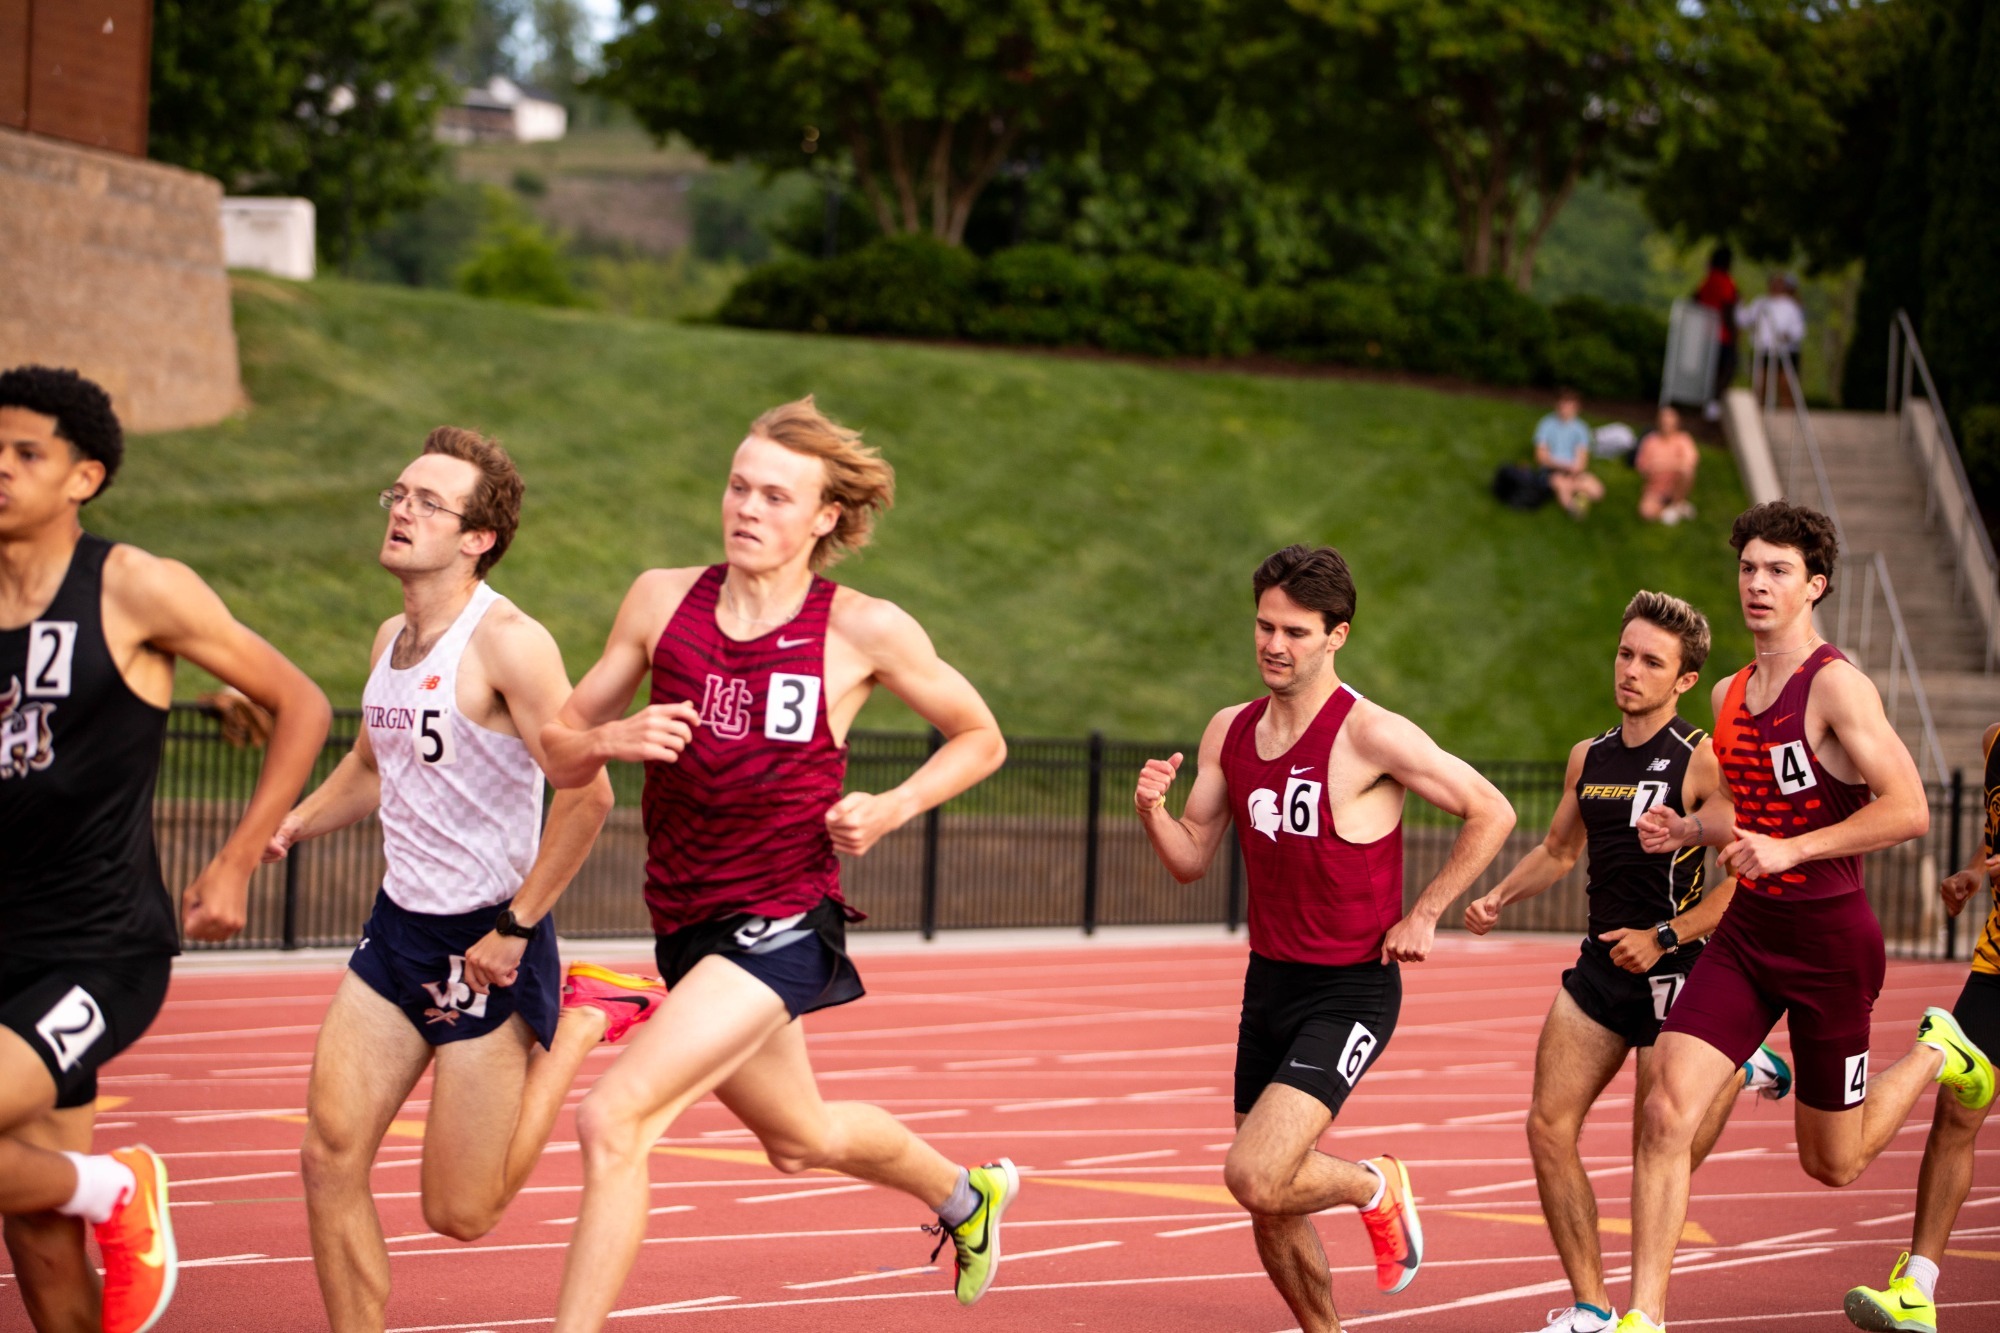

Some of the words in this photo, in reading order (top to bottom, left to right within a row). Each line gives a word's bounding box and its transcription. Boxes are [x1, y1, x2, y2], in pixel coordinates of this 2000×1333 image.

[35, 627, 61, 689] 2
[775, 678, 806, 735] 3
[421, 709, 444, 763] 5
[1781, 746, 1807, 787] 4
[1290, 783, 1312, 832] 6
[1580, 784, 1639, 800] PFEIFF
[1640, 784, 1660, 817] 7
[1656, 976, 1677, 1017] 7
[49, 1000, 95, 1055] 2
[1346, 1034, 1371, 1078] 6
[1850, 1055, 1865, 1098] 4
